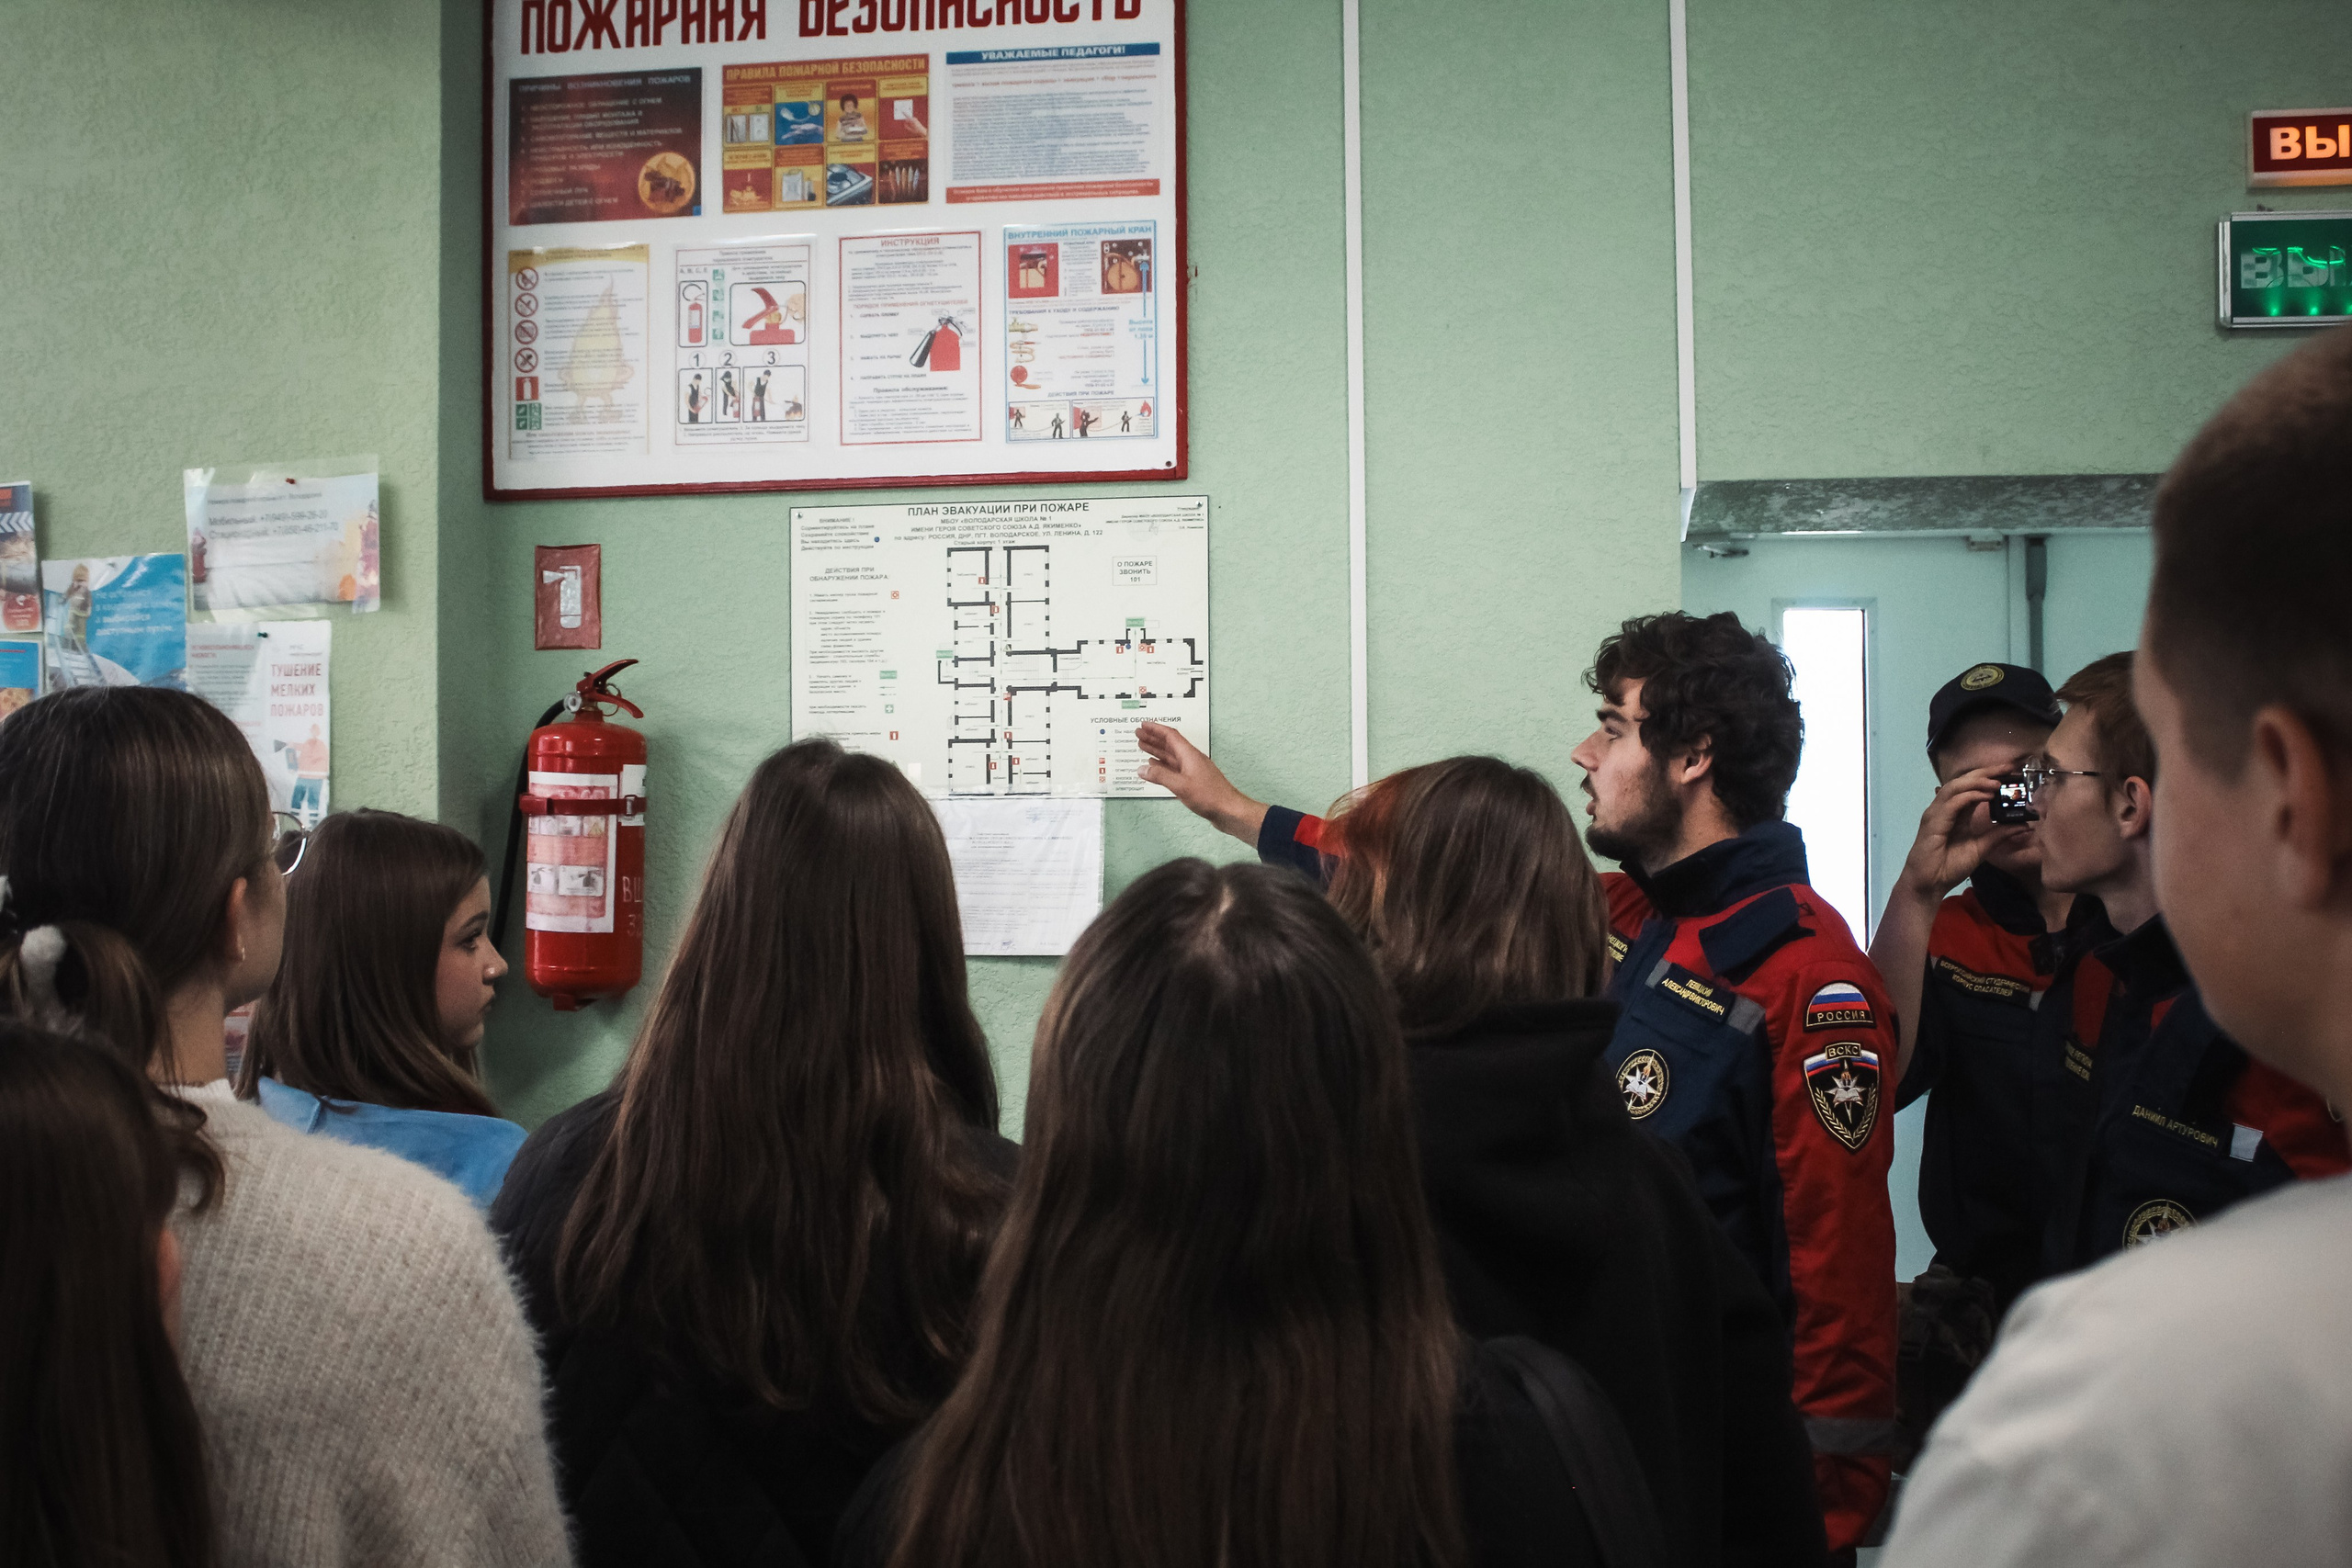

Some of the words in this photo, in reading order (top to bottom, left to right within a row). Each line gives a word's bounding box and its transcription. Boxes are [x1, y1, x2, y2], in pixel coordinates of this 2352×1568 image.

[521, 0, 765, 54] ПОЖАРНАЯ
[981, 49, 1057, 61] УВАЖАЕМЫЕ
[727, 66, 775, 81] ПРАВИЛА
[779, 63, 839, 78] ПОЖАРНОЙ
[842, 58, 925, 75] БЕЗОПАСНОСТИ
[2270, 124, 2350, 161] ВЫ
[1008, 230, 1068, 240] ВНУТРЕННИЙ
[1071, 226, 1125, 237] ПОЖАРНЫЙ
[1128, 226, 1152, 234] КРАН
[881, 237, 940, 247] ИНСТРУКЦИЯ
[694, 353, 700, 367] 1
[723, 352, 732, 367] 2
[766, 351, 776, 366] 3
[908, 507, 939, 516] ПЛАН
[942, 504, 1011, 515] ЭВАКУАЦИИ
[1013, 504, 1037, 513] ПРИ
[1040, 502, 1090, 513] ПОЖАРЕ
[809, 574, 858, 582] ОБНАРУЖЕНИИ
[270, 663, 322, 677] ТУШЕНИЕ
[270, 683, 316, 697] МЕЛКИХ
[270, 704, 323, 716] ПОЖАРОВ
[1817, 1010, 1866, 1023] РОССИЯ
[1828, 1045, 1860, 1057] ВСКС
[2132, 1104, 2166, 1127] ДАНИИЛ
[2166, 1118, 2220, 1149] АРТУРОВИЧ
